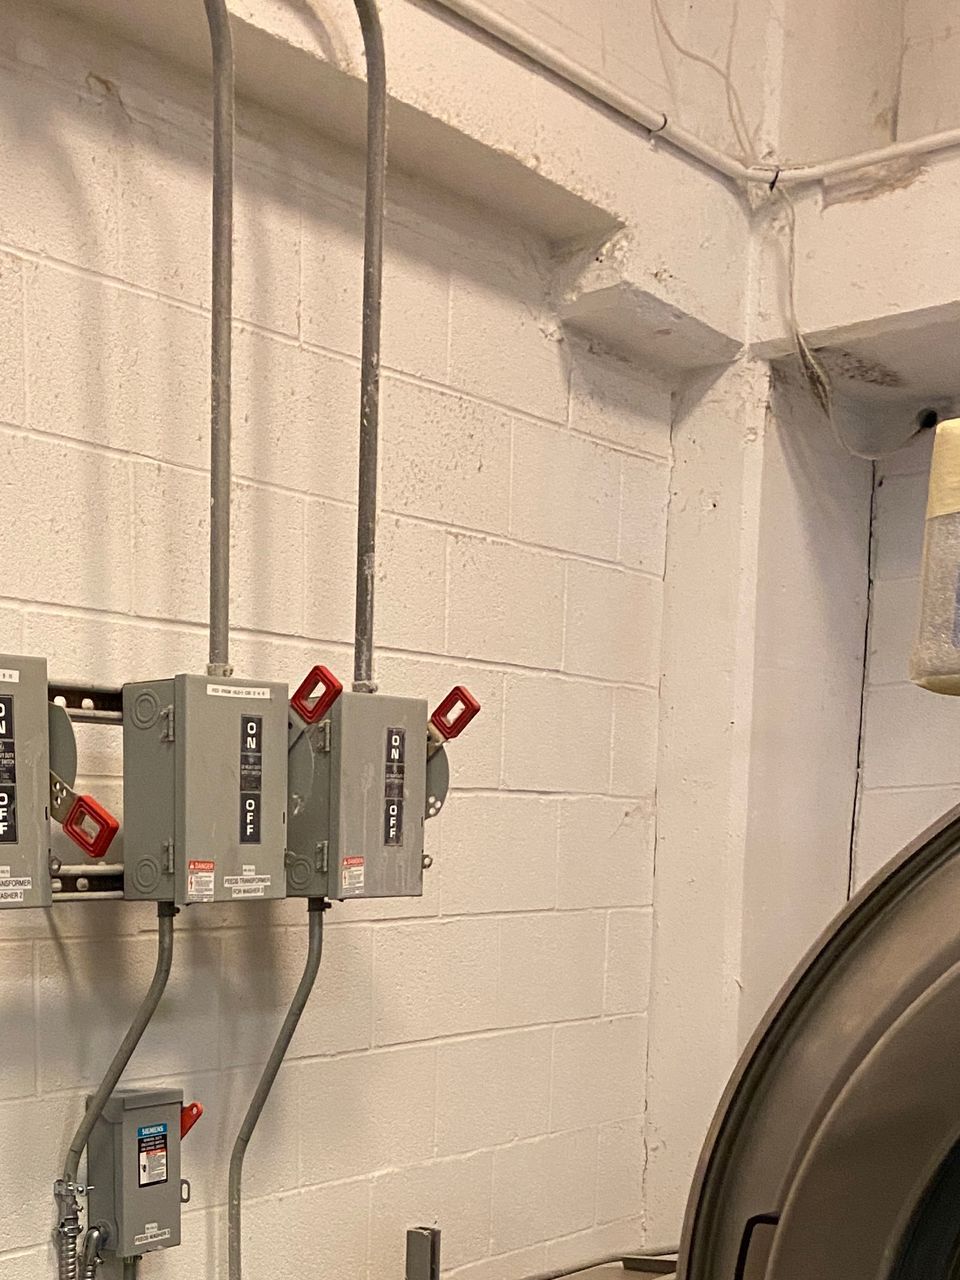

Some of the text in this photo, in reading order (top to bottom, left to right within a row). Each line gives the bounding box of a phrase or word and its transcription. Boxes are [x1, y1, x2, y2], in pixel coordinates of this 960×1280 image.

[246, 722, 257, 749] ON
[390, 735, 400, 760] ON
[245, 799, 255, 836] OFF
[389, 805, 398, 838] OFF
